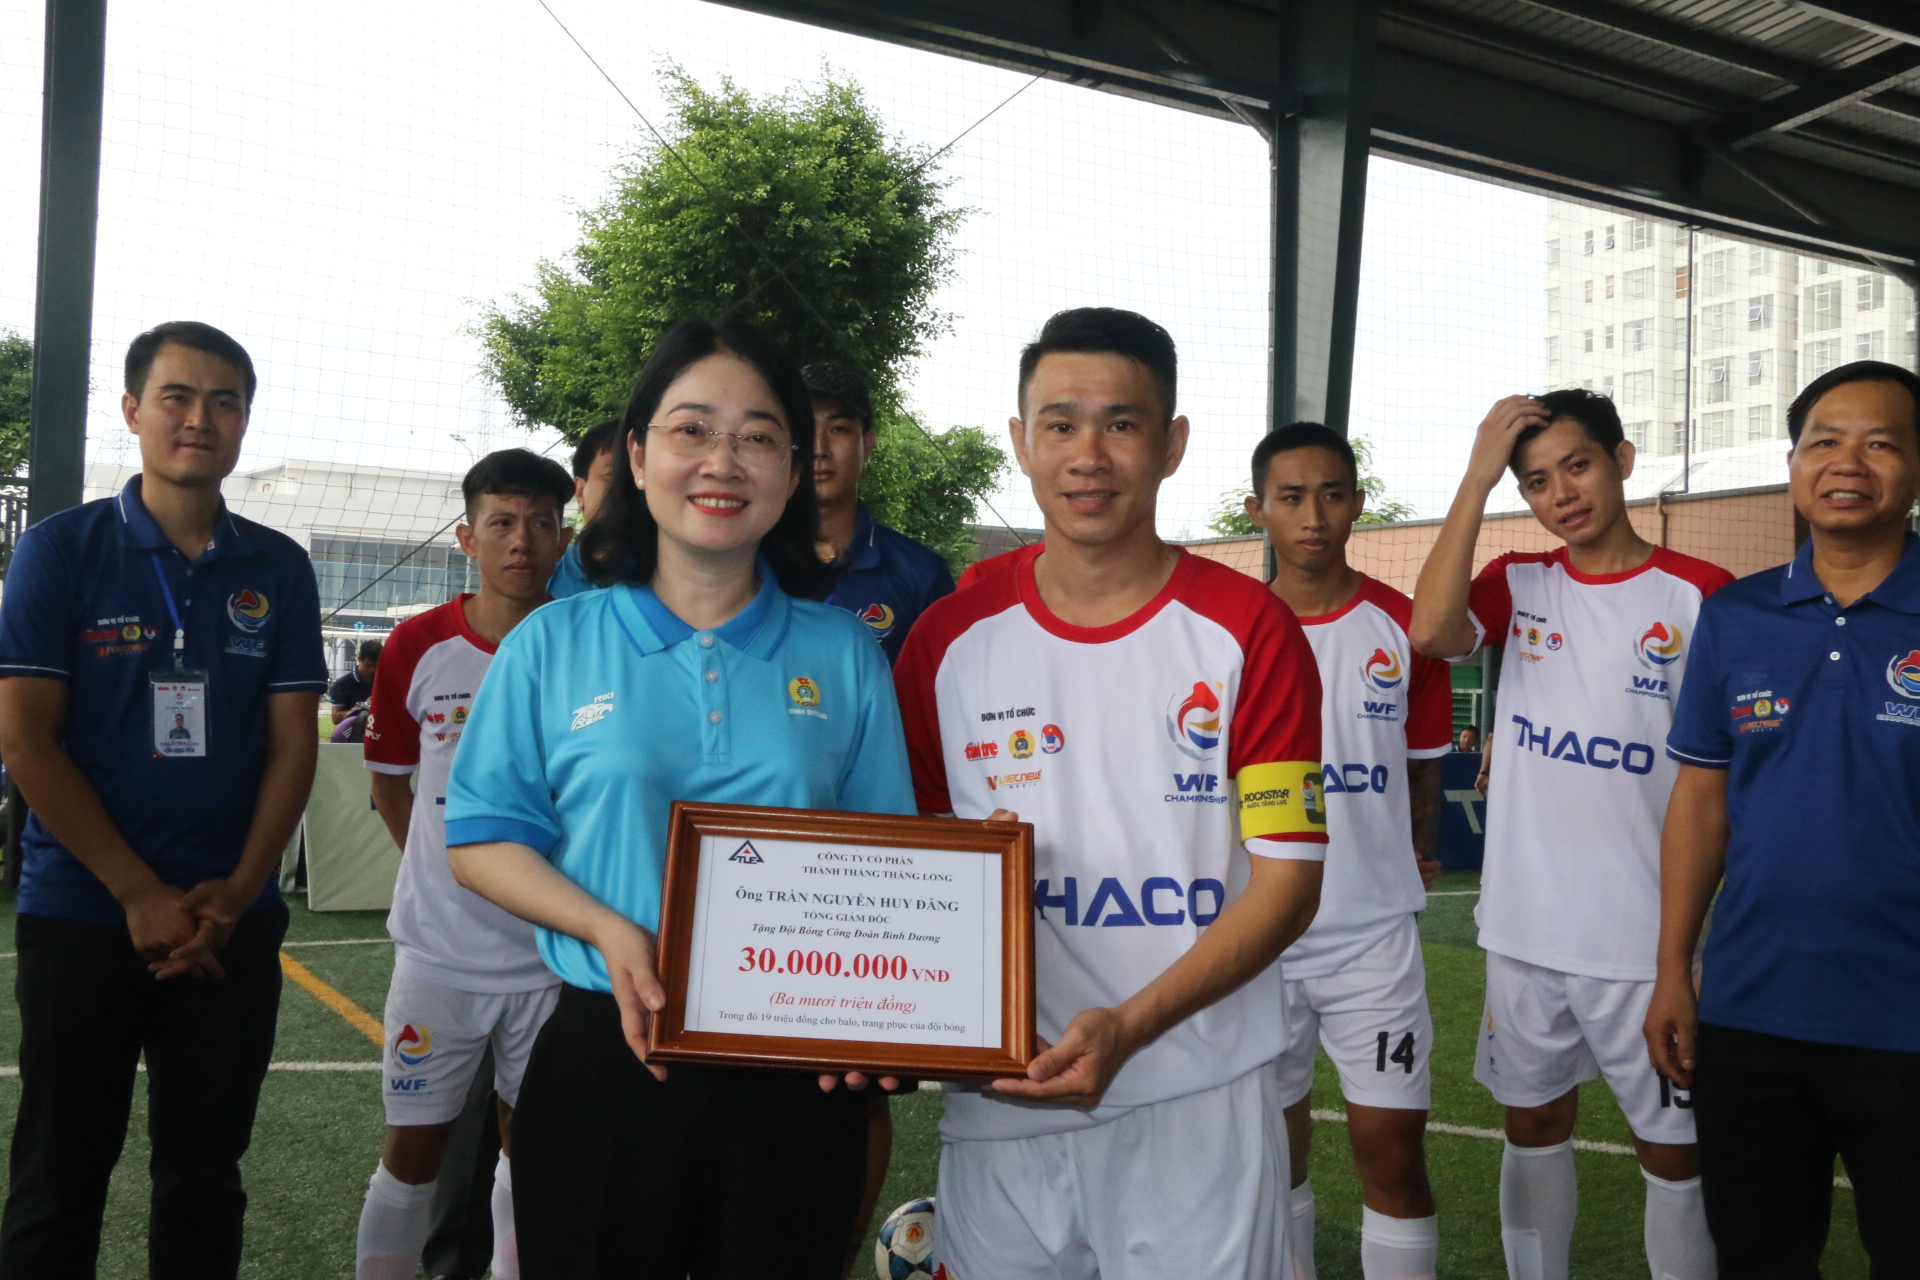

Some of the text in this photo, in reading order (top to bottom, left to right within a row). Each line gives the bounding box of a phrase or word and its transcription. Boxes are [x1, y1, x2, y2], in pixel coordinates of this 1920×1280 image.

[230, 634, 265, 651] WF
[1363, 701, 1397, 715] WF
[1512, 714, 1655, 776] THACO
[1173, 773, 1218, 793] WF
[1322, 763, 1389, 794] ACO
[1244, 788, 1290, 804] ROCKSTAR
[817, 851, 848, 863] CÔNG
[802, 864, 840, 876] THÀNH
[922, 873, 953, 882] LONG
[735, 886, 763, 903] Ông
[880, 897, 912, 910] HUY
[1034, 876, 1225, 928] HACO
[836, 912, 865, 923] GIÁM
[752, 923, 941, 944] Tặng Đội Bóng Công Đoàn Bình Dương
[738, 946, 950, 983] 30.000.000 VNĐ
[769, 992, 917, 1015] (Ba mươi triệu đồng)
[718, 1010, 966, 1034] Trong đó 19 triệu đồng cho balo, trang phục của đội bóng
[1376, 1031, 1416, 1074] 14
[391, 1078, 428, 1091] WF
